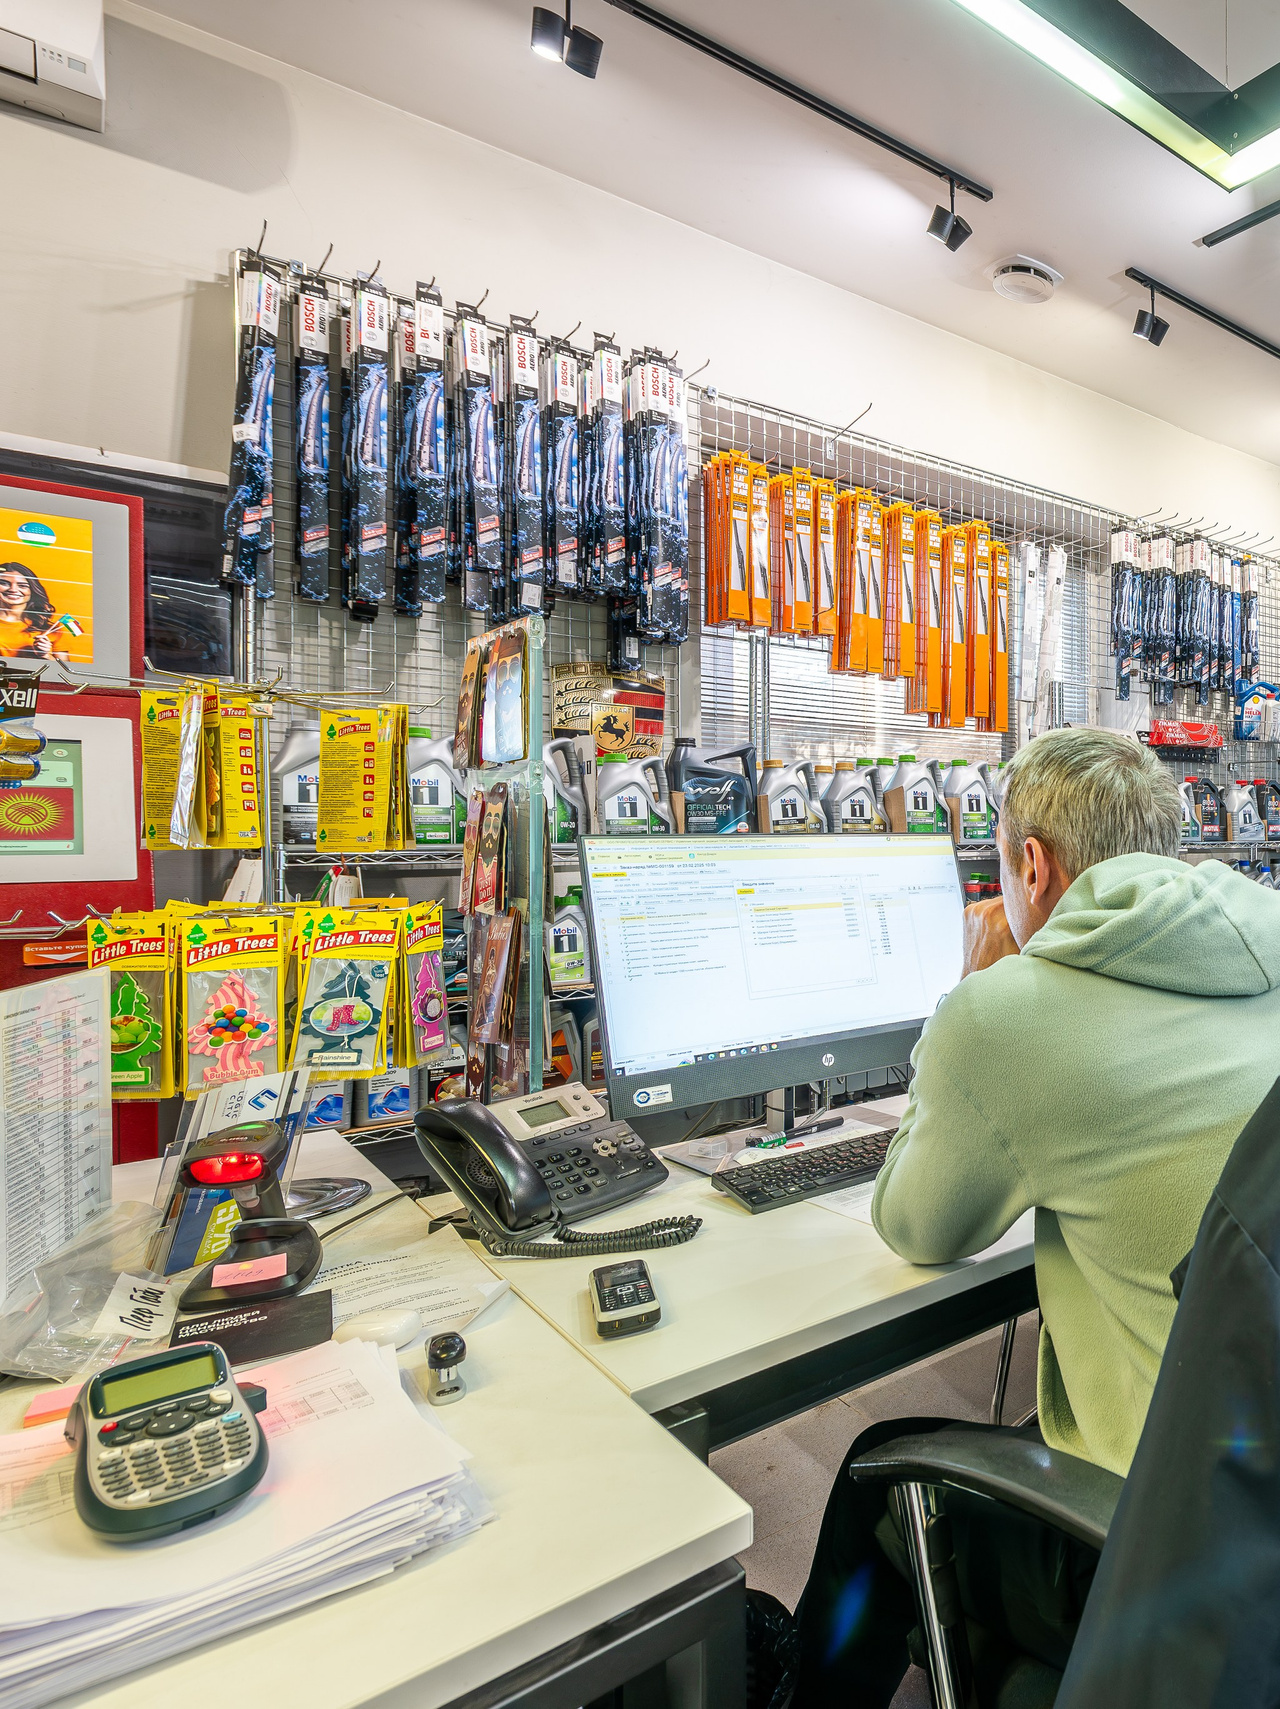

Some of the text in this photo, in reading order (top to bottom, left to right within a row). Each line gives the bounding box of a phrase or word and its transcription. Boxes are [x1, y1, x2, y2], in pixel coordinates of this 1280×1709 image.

[264, 283, 273, 313] BOSCH
[304, 298, 315, 333] BOSCH
[367, 300, 376, 330] BOSCH
[404, 320, 414, 354] BOSCH
[470, 326, 478, 354] BOSCH
[517, 336, 526, 370] BOSCH
[652, 366, 660, 397] BOSCH
[158, 710, 172, 721] Little
[226, 708, 246, 716] Trees
[594, 706, 631, 714] STUTTGART
[338, 724, 370, 738] Little Trees
[306, 785, 318, 802] 1
[418, 788, 430, 802] 1
[687, 780, 738, 802] wolf
[623, 802, 631, 816] 1
[785, 804, 792, 818] 1
[158, 922, 166, 936] 1
[269, 920, 278, 932] 1
[391, 918, 398, 930] 1
[553, 926, 578, 934] Mobil
[315, 930, 394, 951] Little Trees
[406, 924, 440, 947] Little Trees
[560, 935, 570, 952] 1
[65, 944, 89, 952] купю
[92, 938, 164, 964] Little Trees
[188, 937, 276, 964] Little Trees
[822, 1054, 834, 1066] hp
[209, 1068, 260, 1080] Bubble Gum
[224, 1095, 236, 1118] CITY
[231, 1090, 245, 1120] LOGIC
[522, 1094, 543, 1104] Yealink
[317, 1260, 363, 1274] МЯТКА
[178, 1316, 268, 1338] МАСТЕРСТВО
[179, 1318, 247, 1335] ЦЕНЯЩИХ
[180, 1310, 260, 1332] ДЛЯ ЛЮДЕЙ
